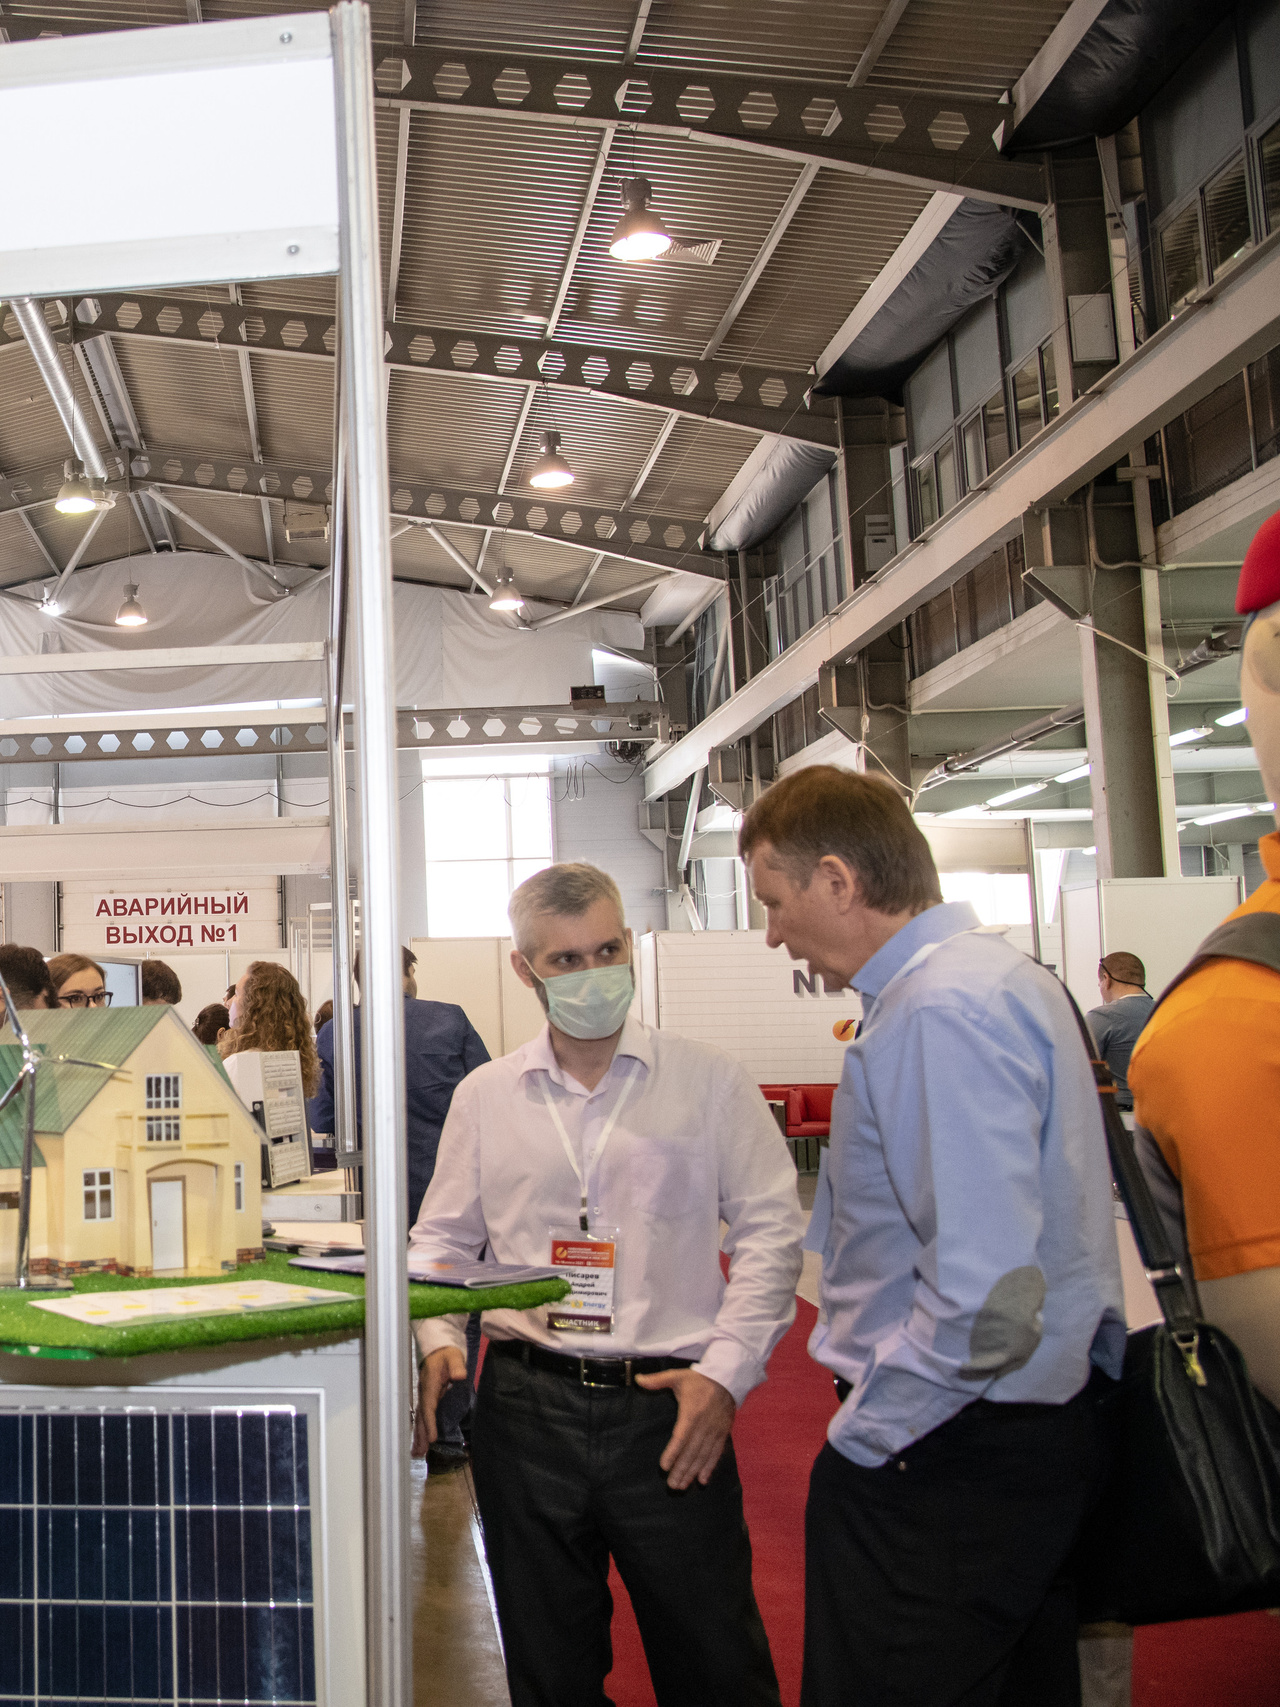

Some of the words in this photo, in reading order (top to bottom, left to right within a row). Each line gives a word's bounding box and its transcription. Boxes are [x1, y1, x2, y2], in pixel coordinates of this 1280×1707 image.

[95, 891, 249, 918] АВАРИЙНЫЙ
[106, 925, 194, 947] ВЫХОД
[201, 923, 238, 943] №1
